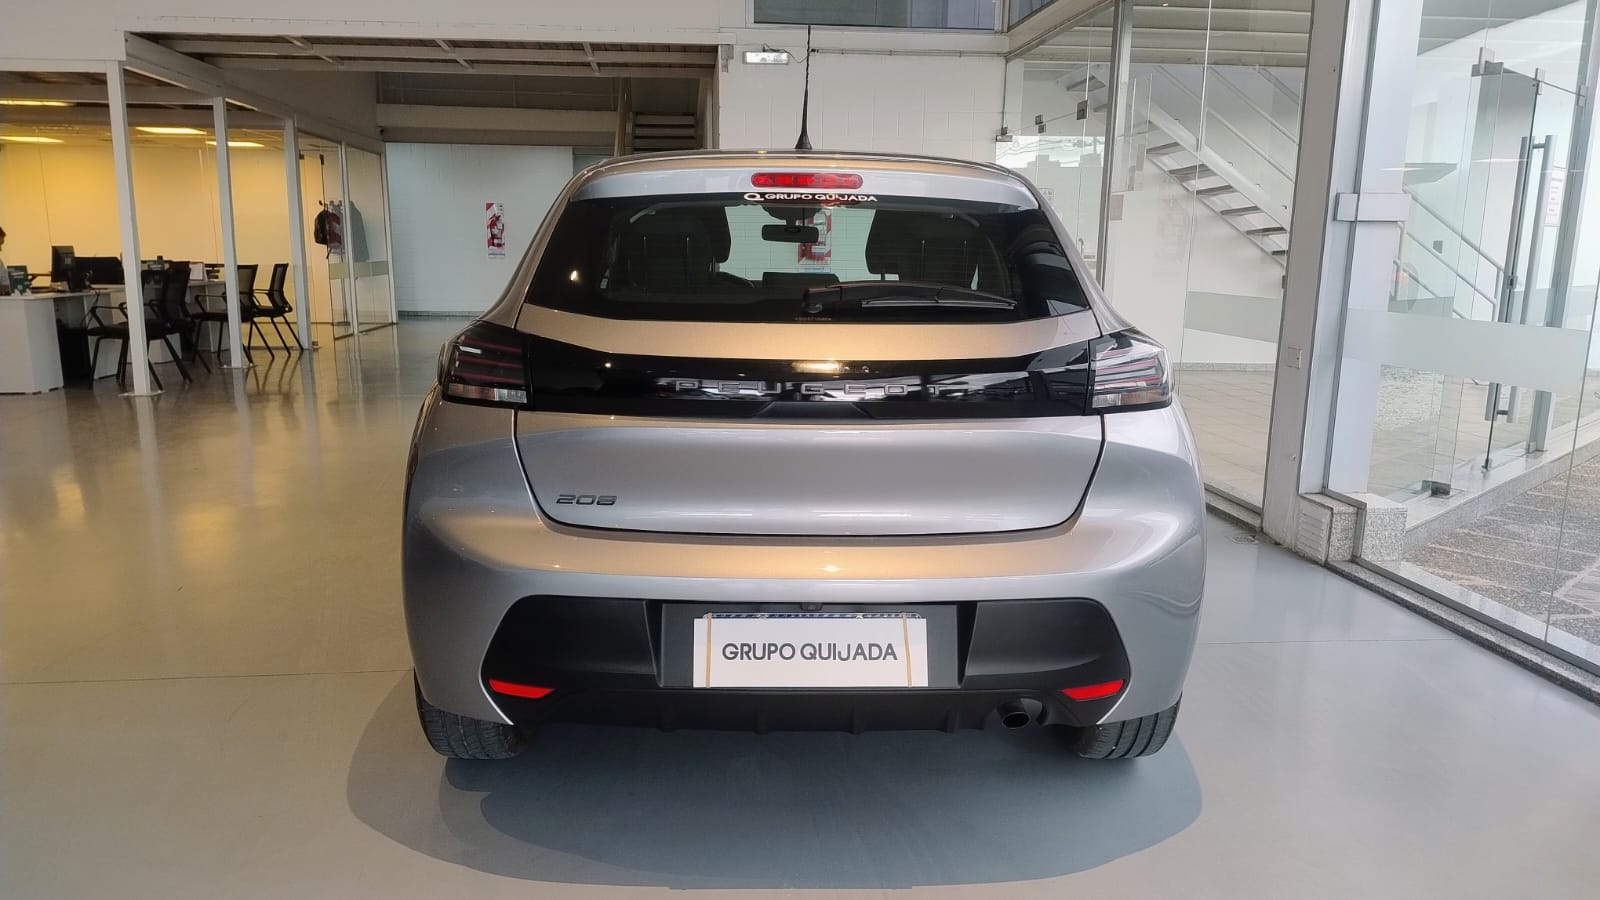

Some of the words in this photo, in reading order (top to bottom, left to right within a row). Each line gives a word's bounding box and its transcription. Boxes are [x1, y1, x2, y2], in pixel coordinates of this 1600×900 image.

[814, 193, 878, 202] QUIJADA
[675, 379, 949, 396] PEUGEOT
[556, 494, 618, 506] 208
[722, 642, 796, 661] GRUPO
[800, 642, 898, 662] QUIJADA
